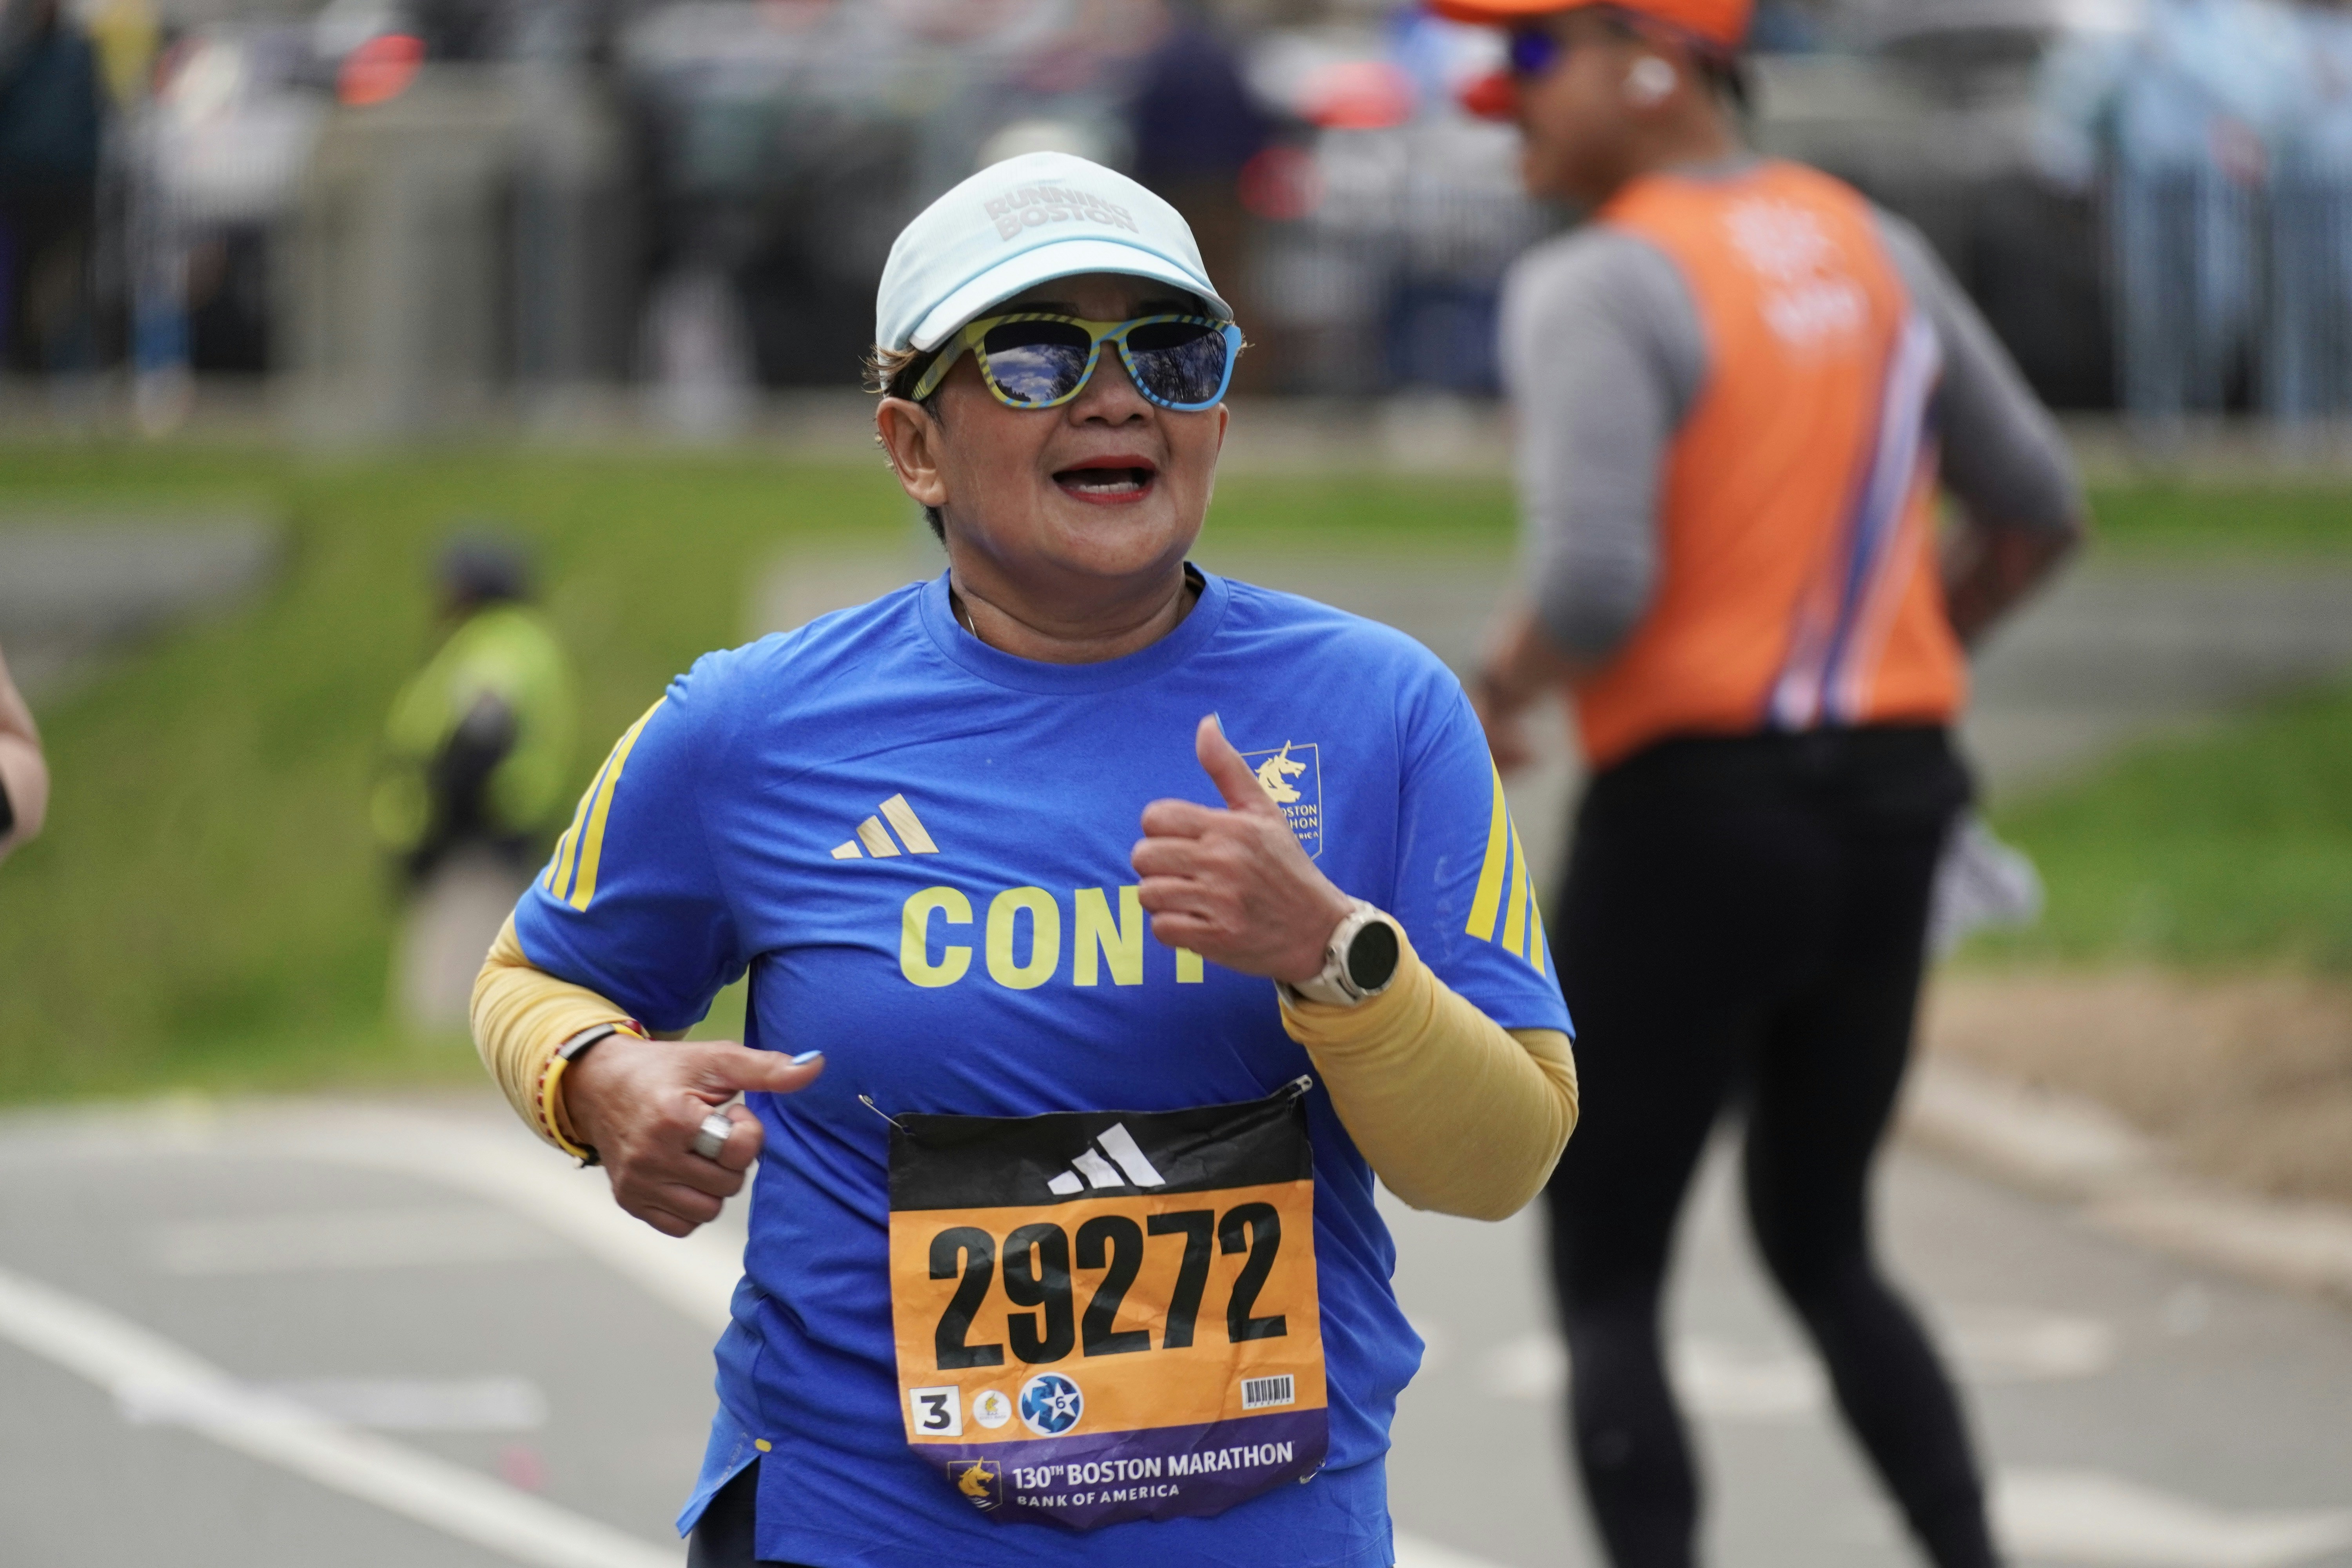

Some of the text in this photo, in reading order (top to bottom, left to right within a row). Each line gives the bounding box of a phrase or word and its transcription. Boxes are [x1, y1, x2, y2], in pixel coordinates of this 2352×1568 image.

[984, 186, 1133, 221] RUNNING
[994, 202, 1140, 241] BOSTON
[1289, 816, 1318, 829] HON
[929, 1202, 1288, 1370] 29272
[921, 1394, 951, 1430] 3
[1056, 1396, 1065, 1409] 6
[1012, 1441, 1293, 1489] 130TH BOSTON MARATHON
[1018, 1484, 1180, 1507] BANK OF AMERICA
